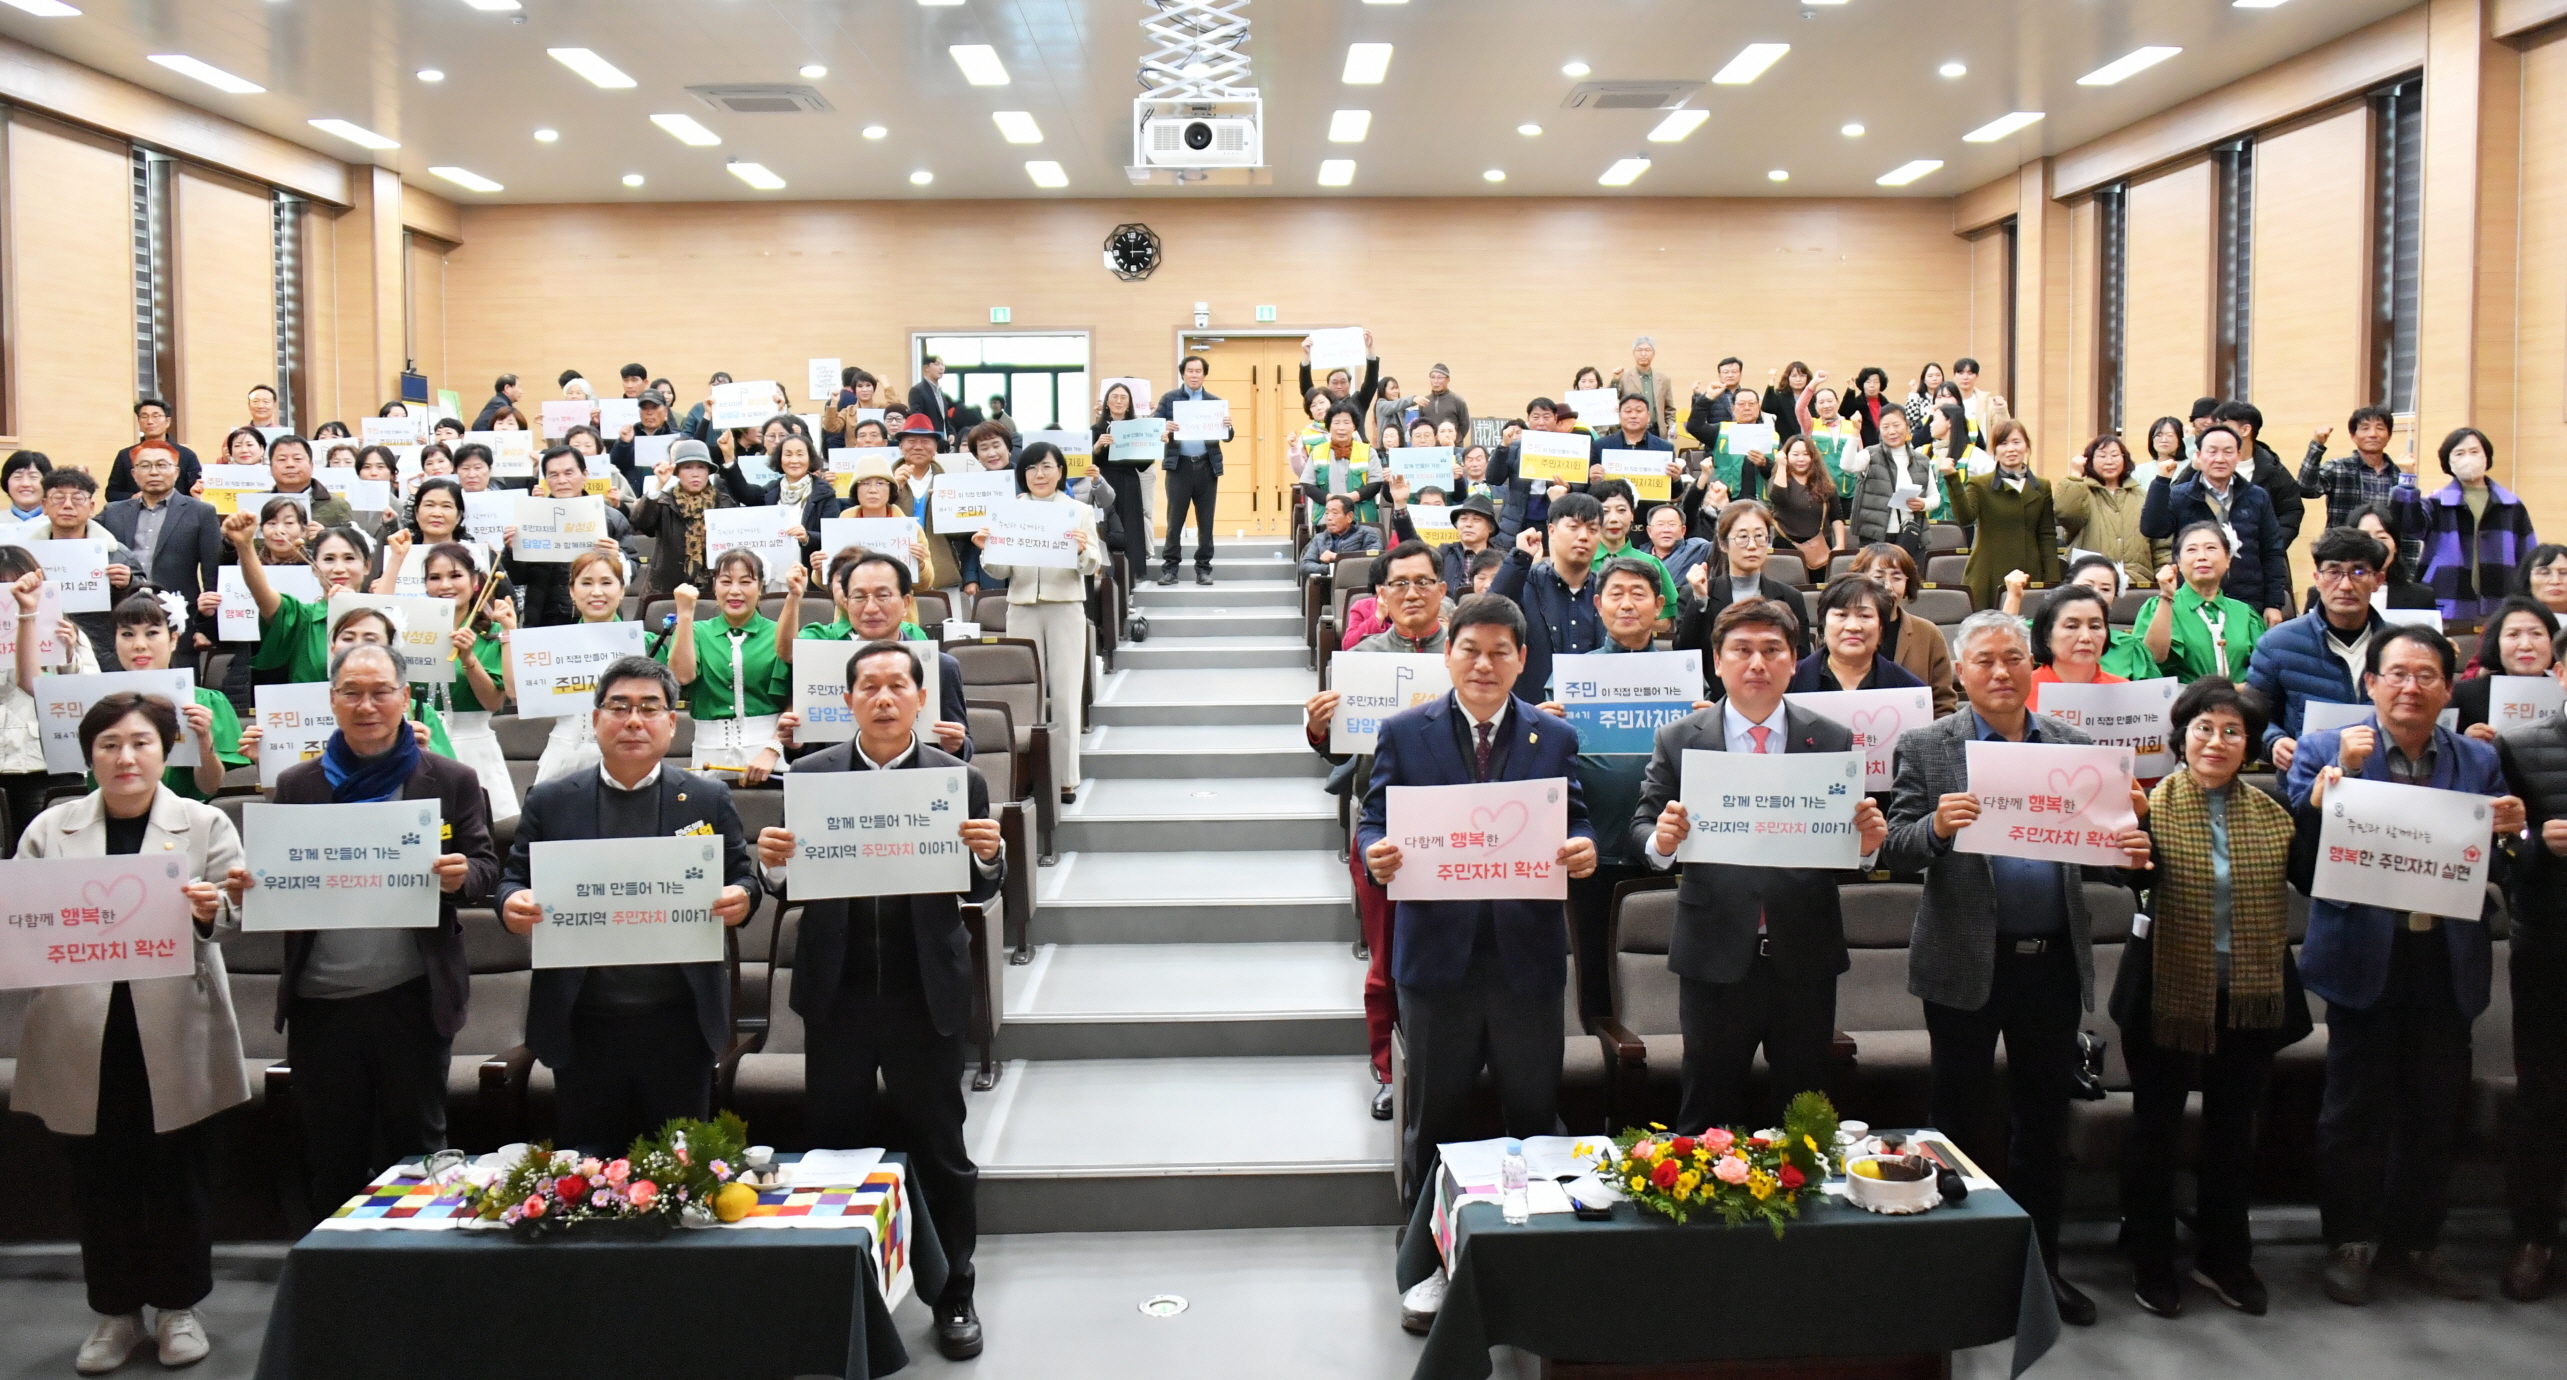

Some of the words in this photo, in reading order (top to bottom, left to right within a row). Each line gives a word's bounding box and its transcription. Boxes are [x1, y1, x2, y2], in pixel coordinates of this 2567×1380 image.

[938, 489, 956, 499] 주민
[564, 521, 596, 533] 활성화
[522, 538, 551, 549] 담양군
[768, 538, 784, 547] 실현
[989, 536, 1014, 547] 행복한
[1017, 537, 1050, 549] 주민자치
[1052, 540, 1069, 550] 실현
[78, 581, 98, 591] 실현
[225, 609, 255, 619] 행복한
[523, 651, 552, 667] 주민
[555, 656, 563, 665] 이
[566, 655, 582, 664] 직접
[583, 653, 608, 663] 만들어
[1565, 681, 1597, 698] 주민
[1602, 687, 1610, 697] 이
[1613, 687, 1631, 697] 직접
[1633, 686, 1661, 697] 만들어
[1663, 686, 1682, 696] 가는
[1347, 695, 1398, 707] 주민자치의
[50, 701, 84, 719] 주민
[2502, 702, 2535, 719] 주민
[268, 711, 300, 728] 주민
[304, 717, 313, 726] 이
[316, 716, 335, 726] 직접
[1346, 718, 1381, 734] 담양
[2085, 717, 2094, 726] 이
[2097, 716, 2114, 726] 직접
[2117, 715, 2141, 725] 만들어
[2144, 713, 2158, 723] 가는
[1723, 794, 1750, 808] 함께
[1755, 795, 1795, 809] 만들어
[1800, 796, 1827, 809] 가는
[1983, 796, 2022, 811] 다함께
[2028, 794, 2076, 814] 행복한
[826, 816, 855, 831] 함께
[859, 814, 900, 829] 만들어
[904, 813, 931, 827] 가는
[1697, 820, 1750, 834] 우리지역
[1754, 821, 1807, 834] 주민자치
[1812, 821, 1852, 835] 이야기
[2347, 818, 2380, 835] 주민과
[1404, 835, 1444, 849] 다함께
[1450, 831, 1500, 849] 행복한
[2008, 825, 2080, 847] 주민자치
[288, 847, 319, 862] 함께
[323, 847, 368, 861] 만들어
[372, 847, 401, 860] 가는
[804, 844, 857, 860] 우리지역
[861, 842, 915, 857] 주민자치
[919, 840, 959, 855] 이야기
[1437, 861, 1507, 881] 주민자치
[1514, 860, 1552, 879] 확산
[2329, 845, 2375, 867] 행복한
[2378, 852, 2439, 877] 주민자치
[2441, 862, 2472, 882] 실현
[264, 874, 320, 890] 우리지역
[326, 874, 382, 889] 주민자치
[387, 873, 429, 888] 이야기
[576, 883, 605, 897] 함께
[610, 881, 652, 896] 만들어
[657, 881, 684, 895] 가는
[8, 912, 54, 929] 다함께
[60, 907, 116, 927] 행복한
[552, 911, 607, 927] 우리지역
[611, 909, 667, 925] 주민자치
[671, 908, 713, 923] 이야기
[47, 940, 127, 964] 주민자치
[134, 938, 176, 958] 확산
